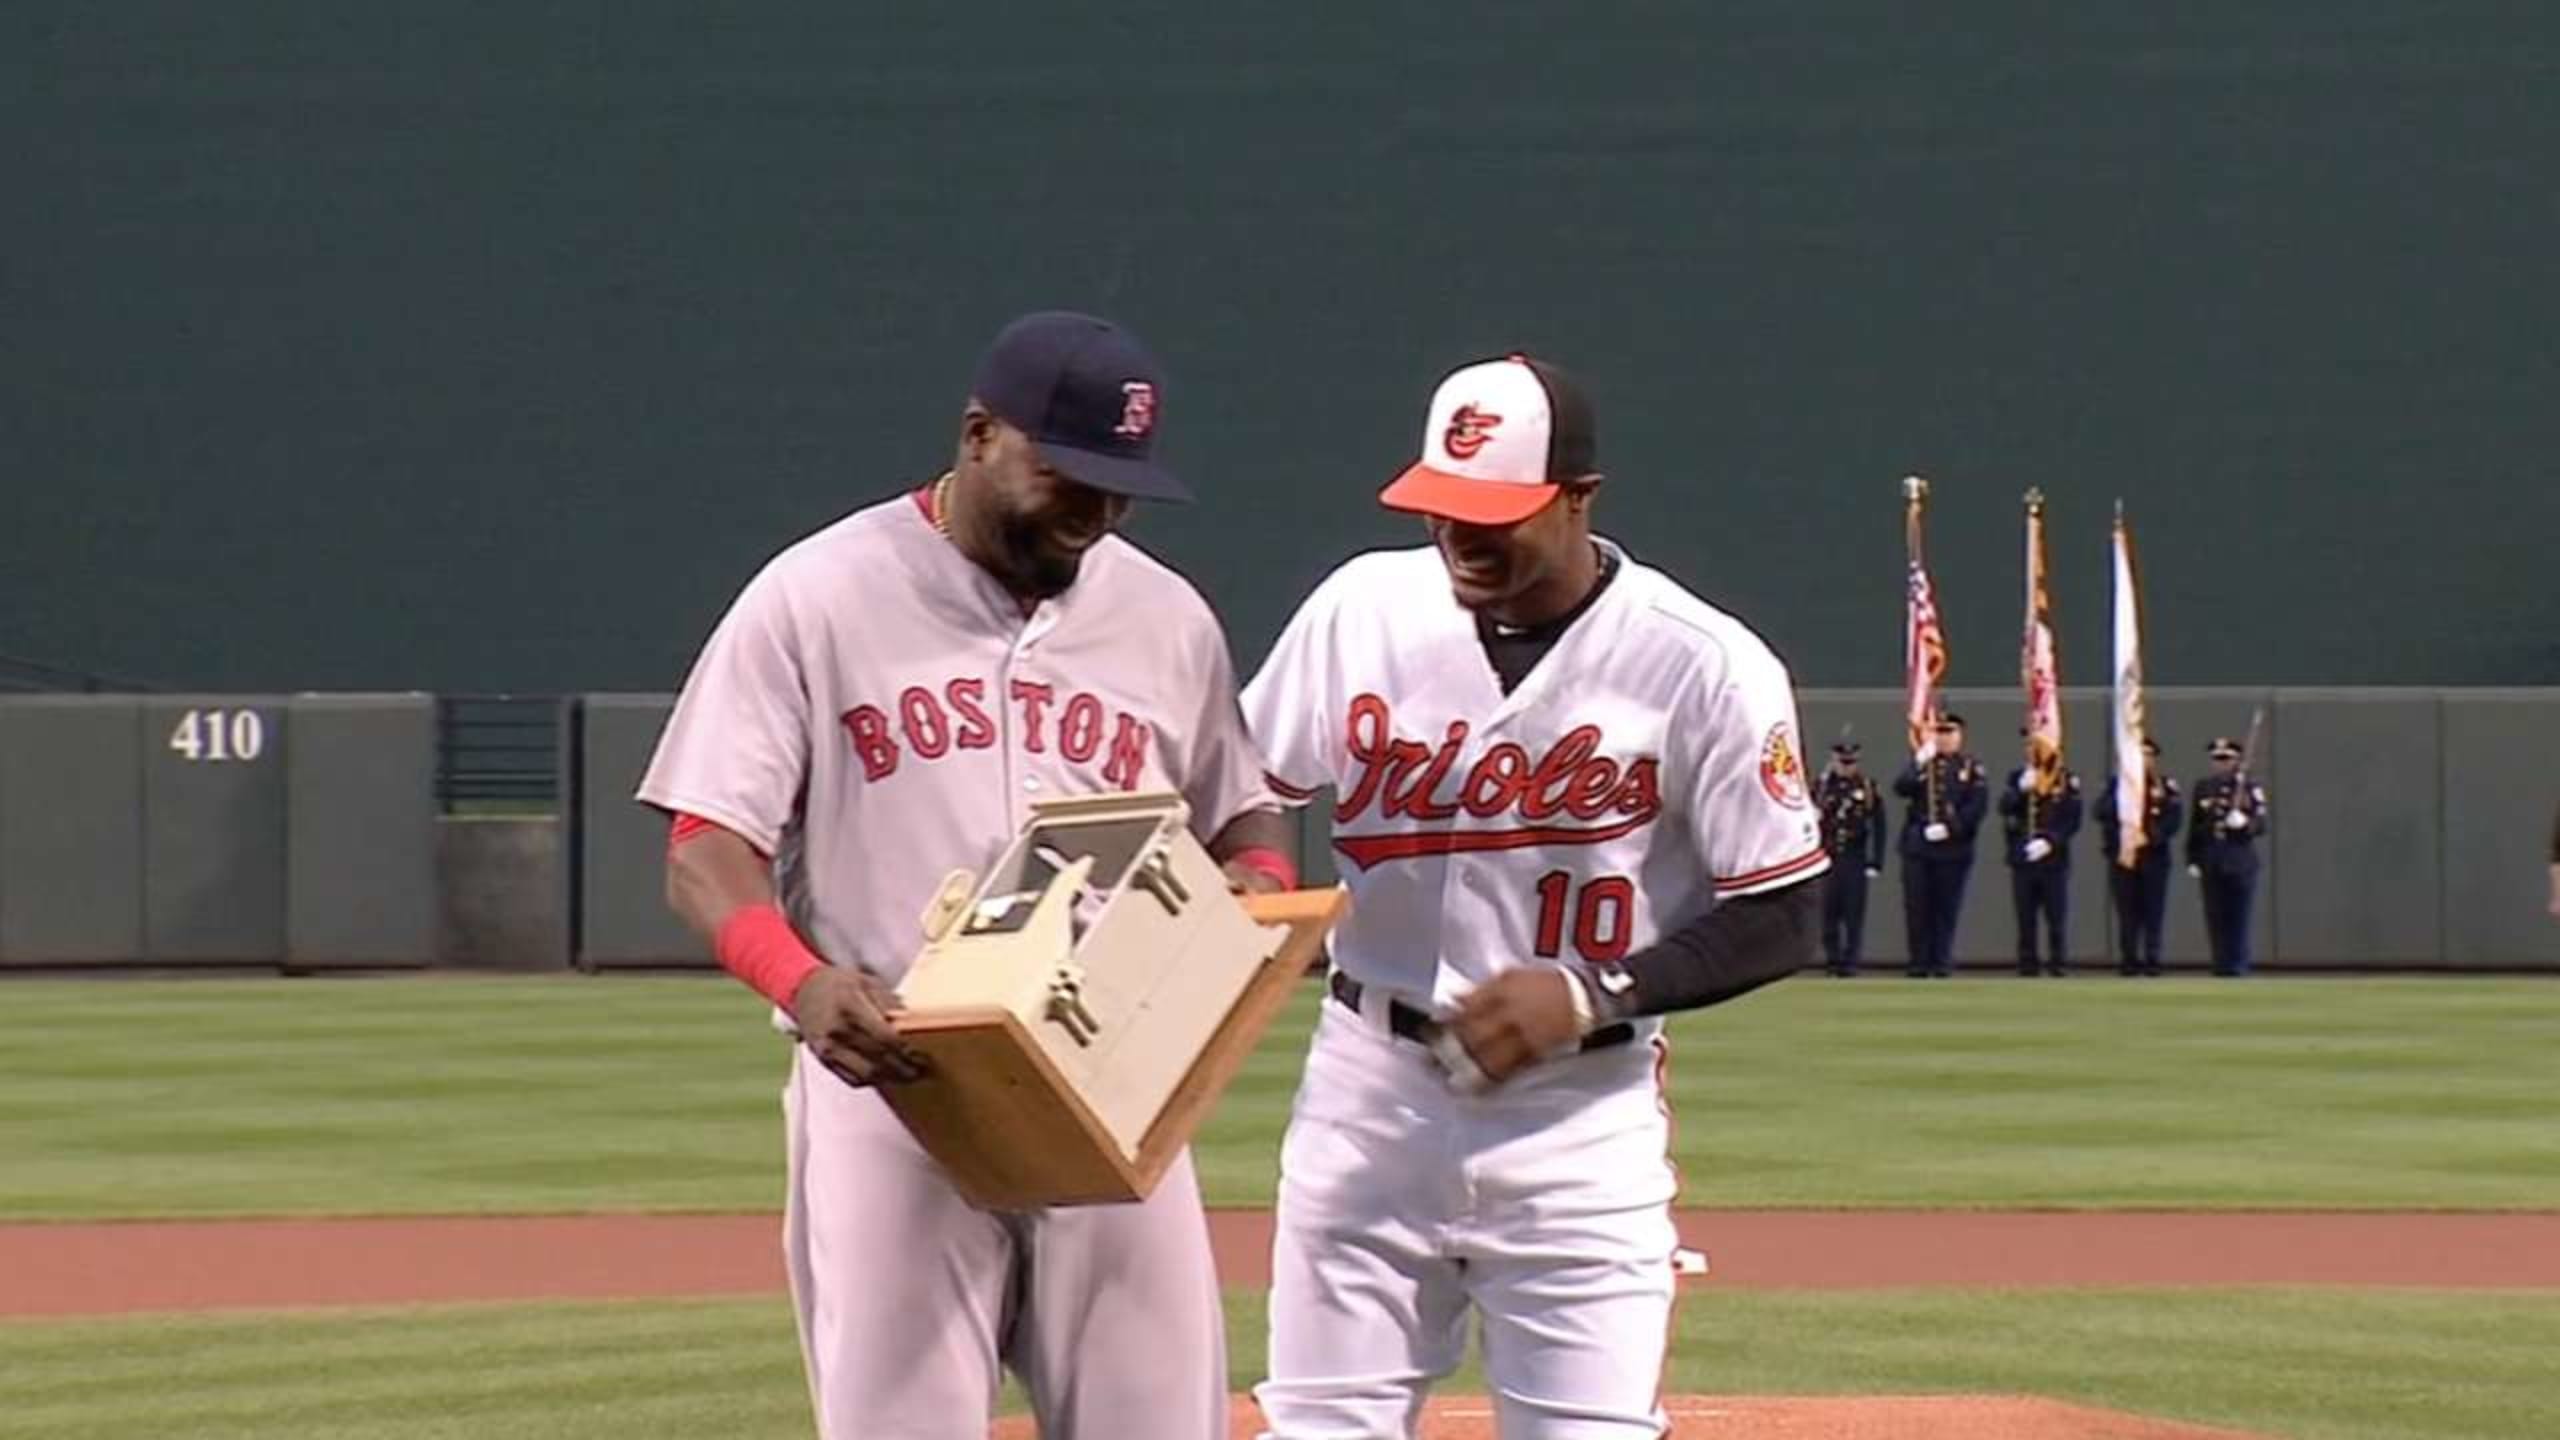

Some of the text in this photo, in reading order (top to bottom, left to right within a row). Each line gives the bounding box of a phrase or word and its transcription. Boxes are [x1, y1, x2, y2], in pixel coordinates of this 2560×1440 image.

[170, 709, 262, 760] 410
[840, 678, 1150, 791] BOSTON
[1333, 693, 1662, 823] Orioles
[1534, 870, 1635, 962] 10
